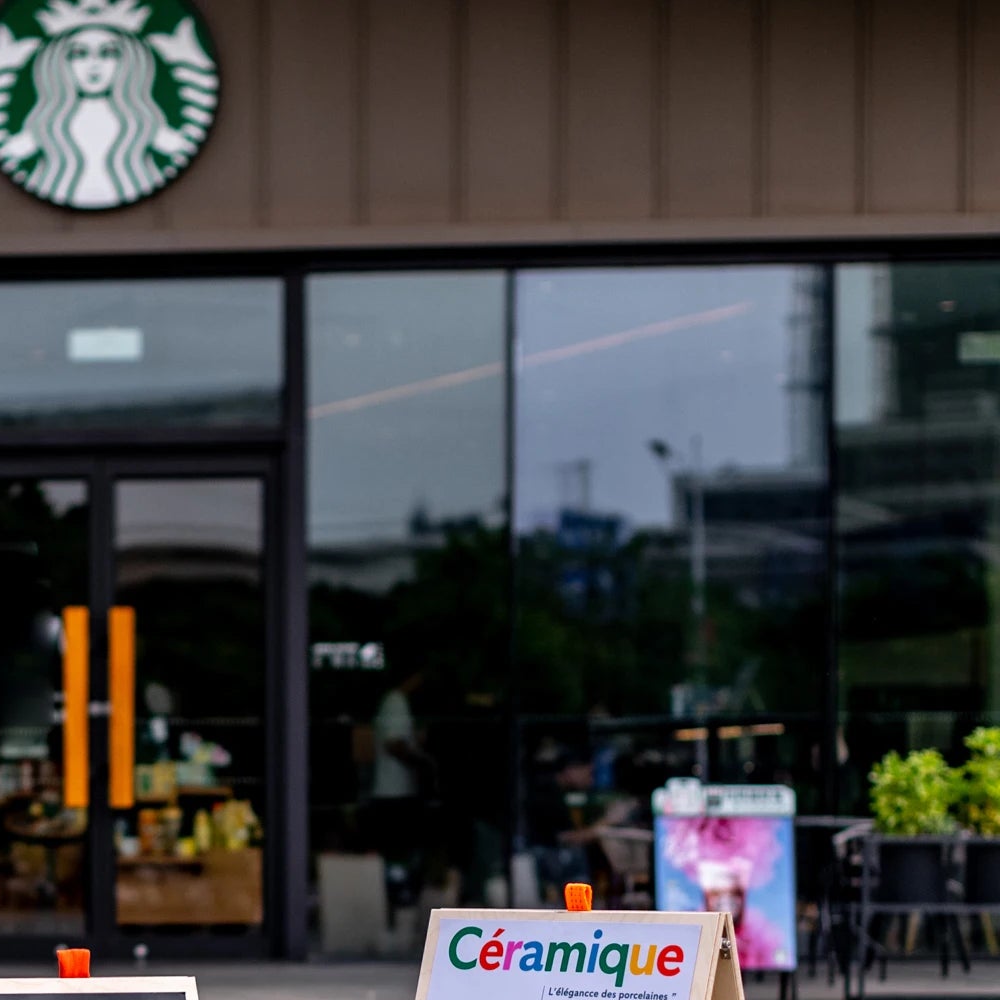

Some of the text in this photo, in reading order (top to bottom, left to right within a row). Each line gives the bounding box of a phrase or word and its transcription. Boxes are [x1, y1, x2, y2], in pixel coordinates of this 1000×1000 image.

[448, 926, 685, 987] Céramique
[601, 989, 616, 999] des
[618, 990, 668, 1000] porcelaines
